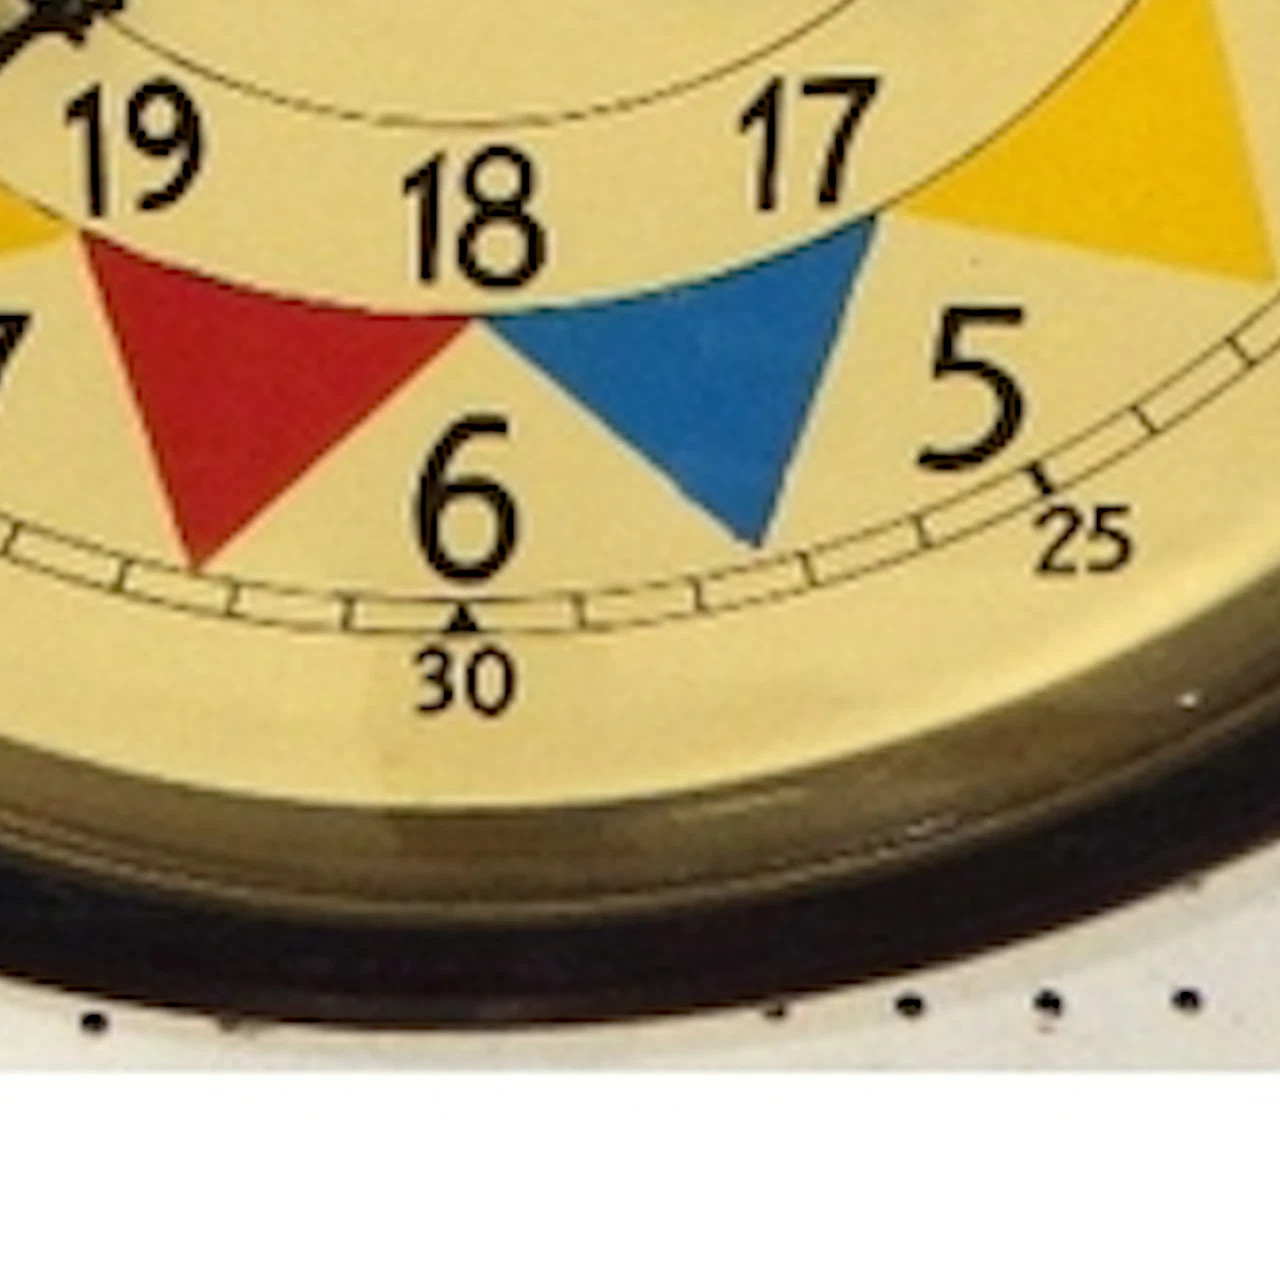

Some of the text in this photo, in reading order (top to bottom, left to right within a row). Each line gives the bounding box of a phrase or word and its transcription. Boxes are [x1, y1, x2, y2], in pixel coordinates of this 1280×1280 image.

[66, 76, 204, 216] 19
[738, 74, 880, 214] 17
[402, 147, 547, 291] 18
[915, 304, 1026, 474] 5
[412, 413, 519, 586] 6
[1033, 503, 1133, 575] 25
[414, 642, 517, 719] 30
